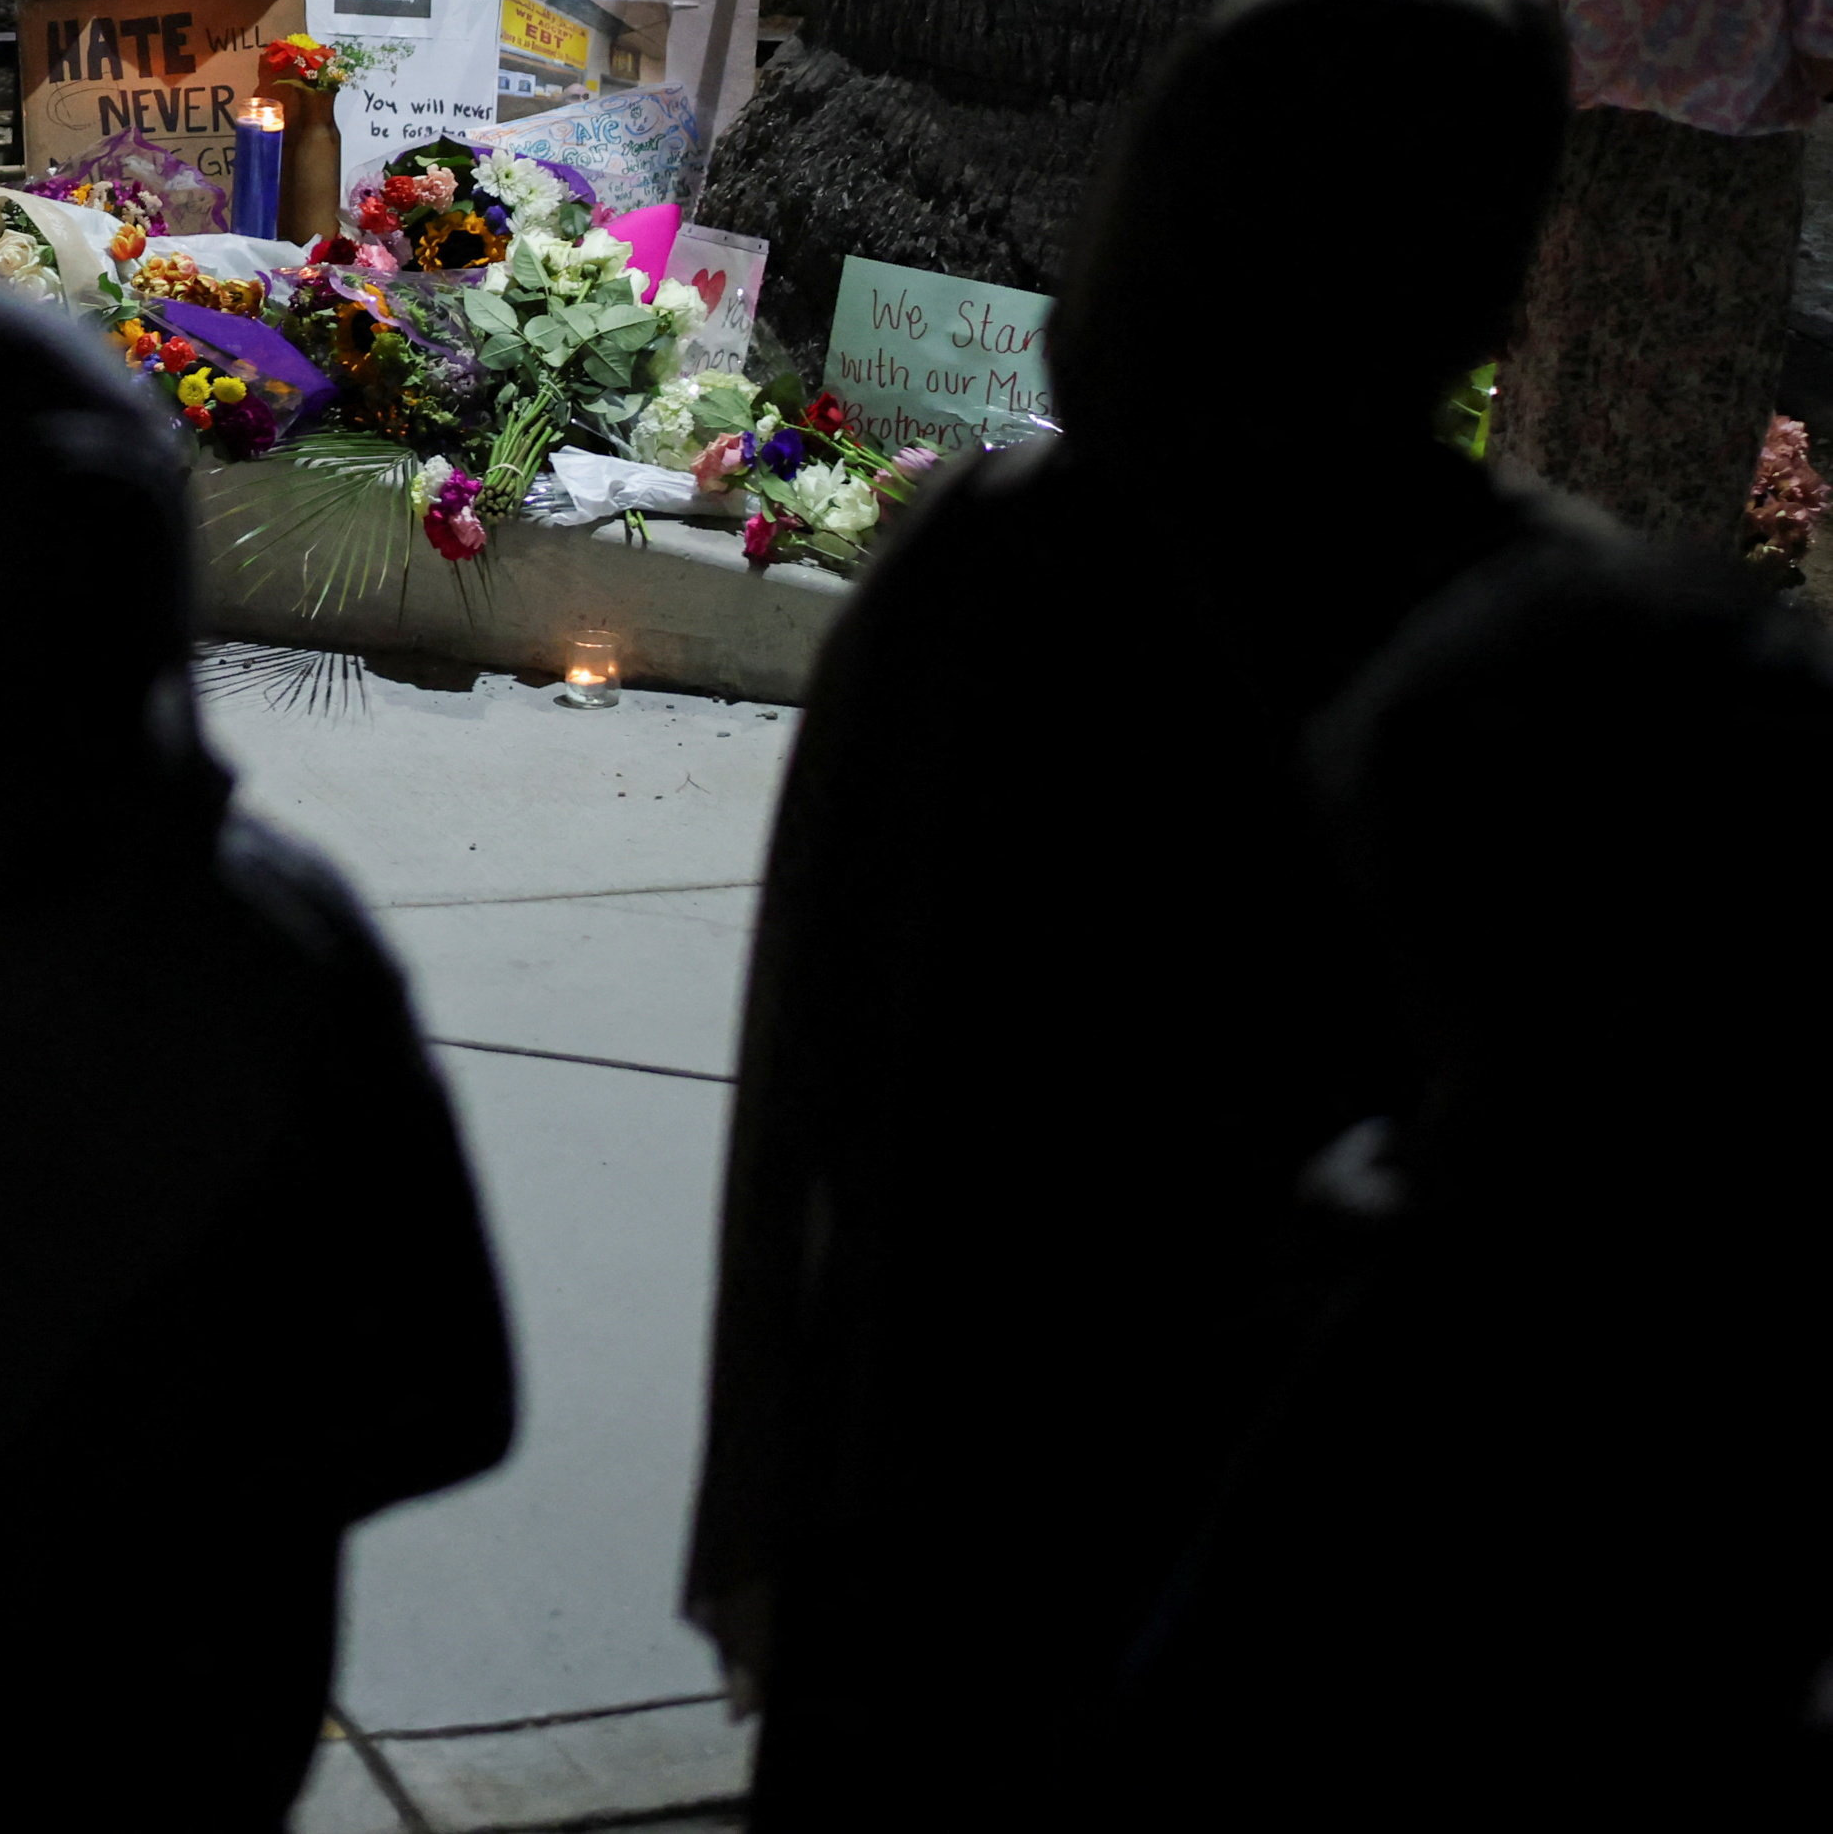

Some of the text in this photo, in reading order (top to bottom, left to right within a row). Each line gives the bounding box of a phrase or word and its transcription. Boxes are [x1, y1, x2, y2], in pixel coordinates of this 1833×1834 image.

[47, 12, 268, 83] HATE WILL
[525, 22, 564, 49] EBT
[98, 85, 236, 137] NEVER
[363, 88, 398, 115] You
[410, 98, 444, 115] will
[370, 120, 390, 139] be
[872, 288, 928, 340] We
[840, 347, 1049, 416] with our Mus
